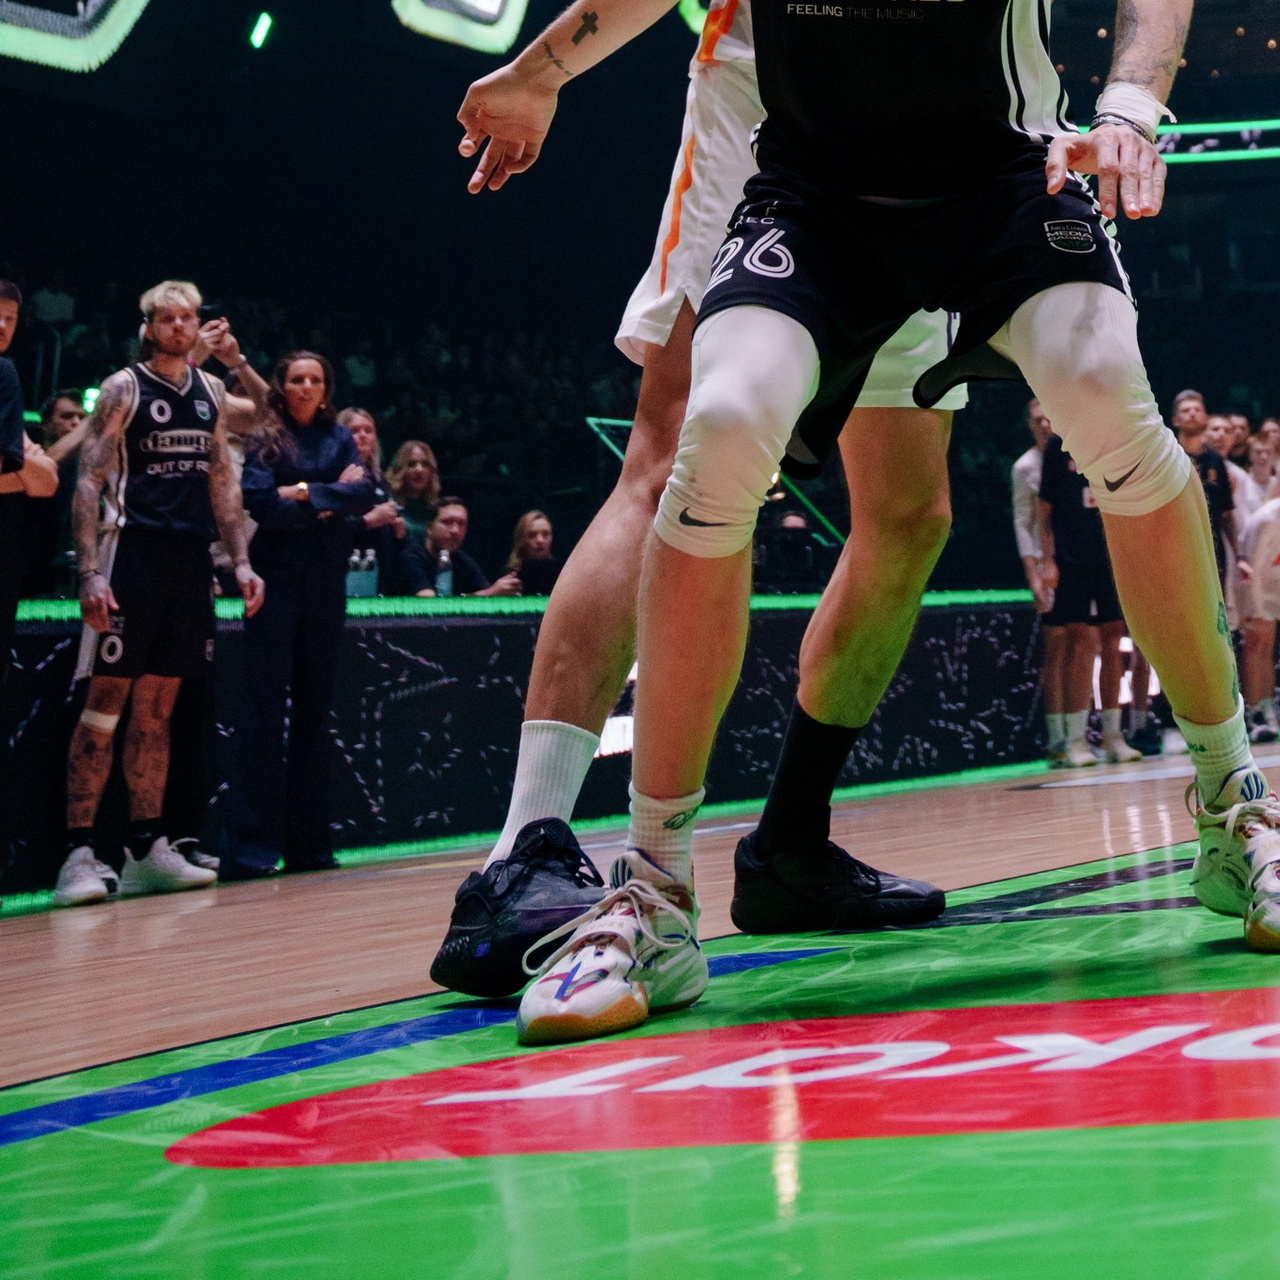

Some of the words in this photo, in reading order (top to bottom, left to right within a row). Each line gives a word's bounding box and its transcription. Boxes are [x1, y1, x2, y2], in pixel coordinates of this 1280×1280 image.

[786, 3, 843, 17] FEELING
[846, 7, 873, 19] THE
[876, 8, 925, 21] MUSIC
[703, 228, 795, 298] 26
[150, 399, 172, 423] 0
[146, 460, 176, 476] OUT
[178, 460, 194, 472] OF
[100, 635, 124, 664] 0
